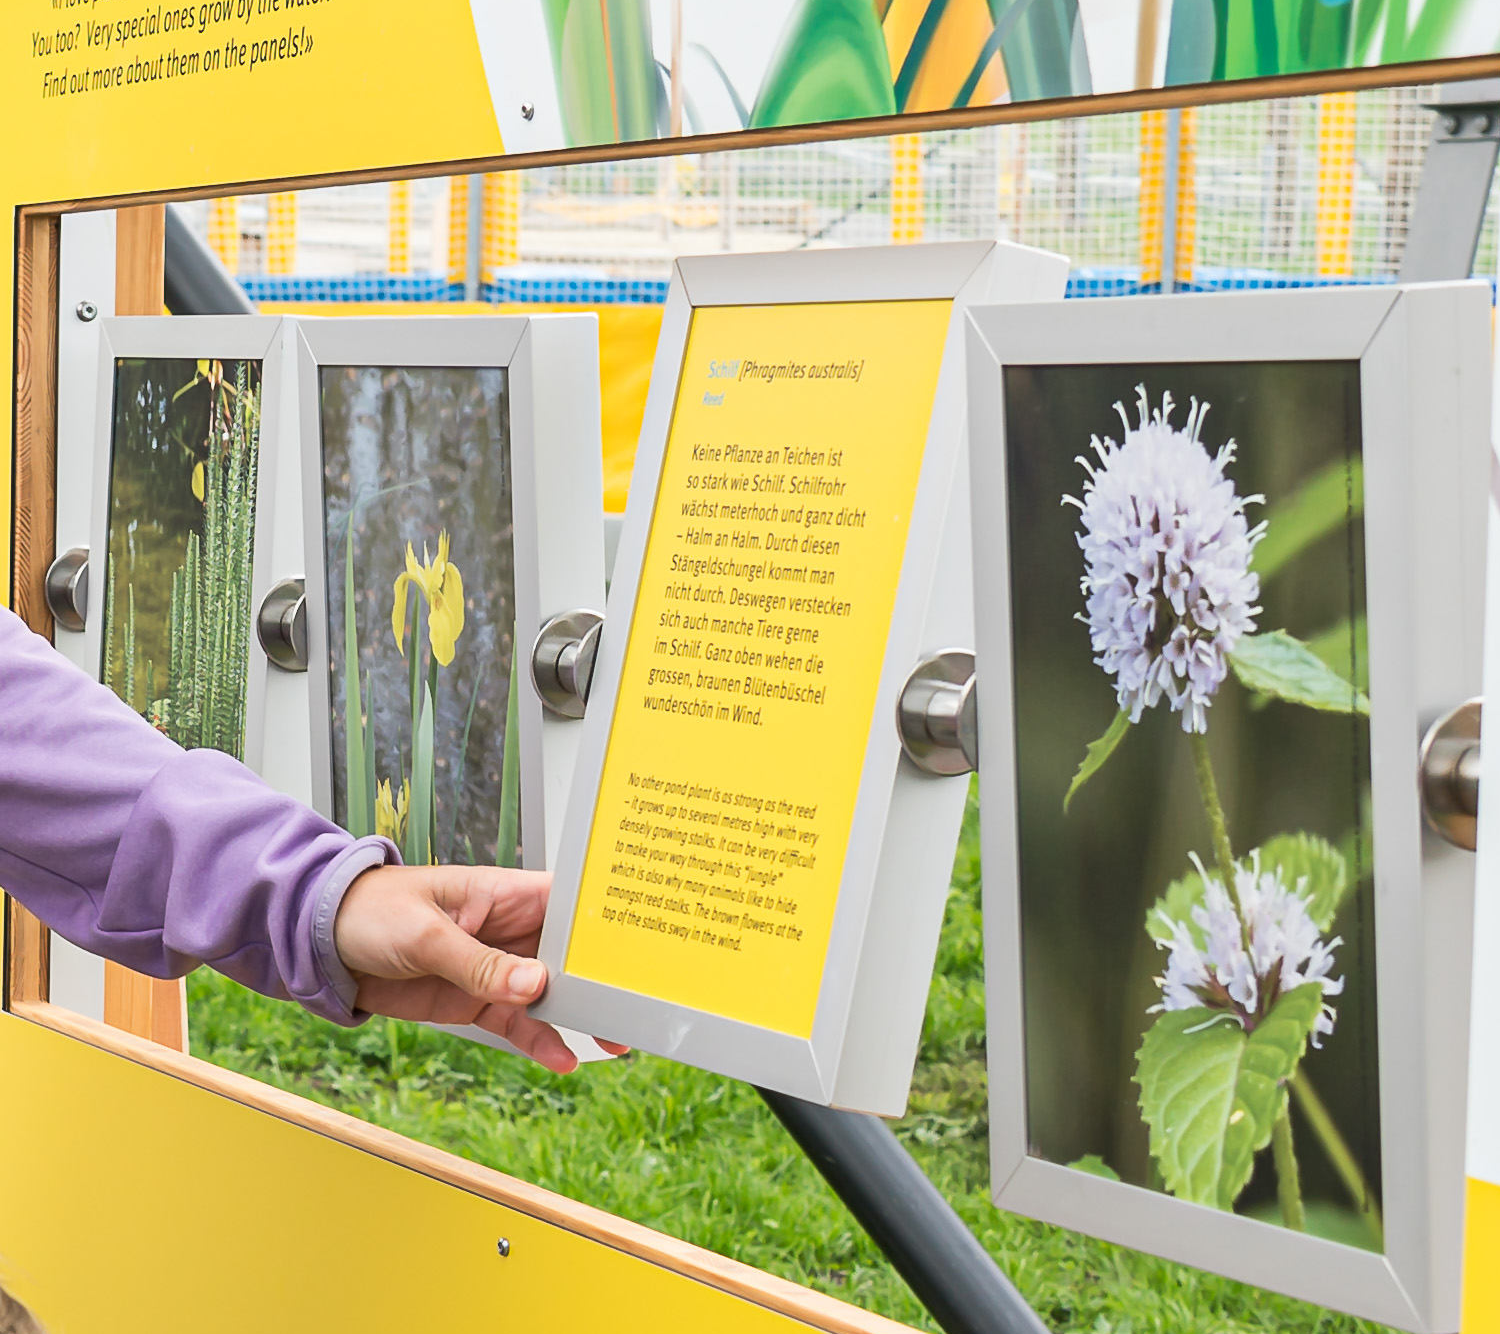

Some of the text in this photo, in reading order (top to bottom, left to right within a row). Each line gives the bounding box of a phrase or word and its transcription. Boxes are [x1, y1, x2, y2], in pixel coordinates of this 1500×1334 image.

[32, 31, 52, 57] You
[55, 22, 81, 54] too?
[87, 20, 114, 51] Very
[115, 5, 161, 47] special
[163, 6, 195, 32] ones
[198, 0, 234, 34] grow
[42, 69, 67, 98] Find
[69, 67, 90, 94] out
[92, 65, 123, 90] more
[126, 53, 164, 85] about
[166, 48, 199, 78] them
[203, 48, 220, 72] on
[224, 37, 247, 69] the
[708, 359, 864, 383] Schilf [Phragmites australis]
[691, 443, 843, 467] Keine Pflanze an Teichen ist
[686, 473, 847, 496] so stark wie Schilf. Schilfrohr
[681, 499, 866, 529] wächst meterhoch und ganz dicht
[685, 527, 713, 545] Halm
[714, 533, 729, 547] an
[730, 531, 761, 549] Halm.
[765, 532, 798, 552] Durch
[801, 535, 840, 555] diesen
[669, 553, 835, 584] Stängeldschungel kommt man
[664, 581, 851, 616] nicht durch. Deswegen verstecken
[659, 609, 819, 645] sich auch manche Tiere gerne
[653, 636, 824, 674] im Schilf. Ganz oben wehen die
[647, 668, 826, 704] grossen, braunen Blütenbüschel
[643, 694, 762, 726] wunderschön im Wind.
[627, 772, 817, 820] No other pond plant is as strong as the reed
[631, 795, 639, 810] it
[637, 800, 665, 815] grows
[665, 806, 677, 819] up
[677, 805, 688, 819] to
[687, 809, 721, 825] several
[720, 816, 752, 832] metres
[754, 819, 775, 839] high
[776, 825, 797, 840] with
[798, 831, 820, 848] very
[614, 839, 624, 853] to
[624, 843, 648, 858] make
[647, 849, 669, 862] your
[669, 853, 687, 868] way
[687, 854, 723, 877] through
[723, 861, 742, 878] this
[619, 816, 816, 869] densely growing stalks. It can be very difficult
[610, 861, 797, 915] which is also why many animals like to hide
[601, 905, 741, 951] top of the stalks sway in the wind.
[606, 885, 803, 941] amongst reed stalks. The brown flowers at the
